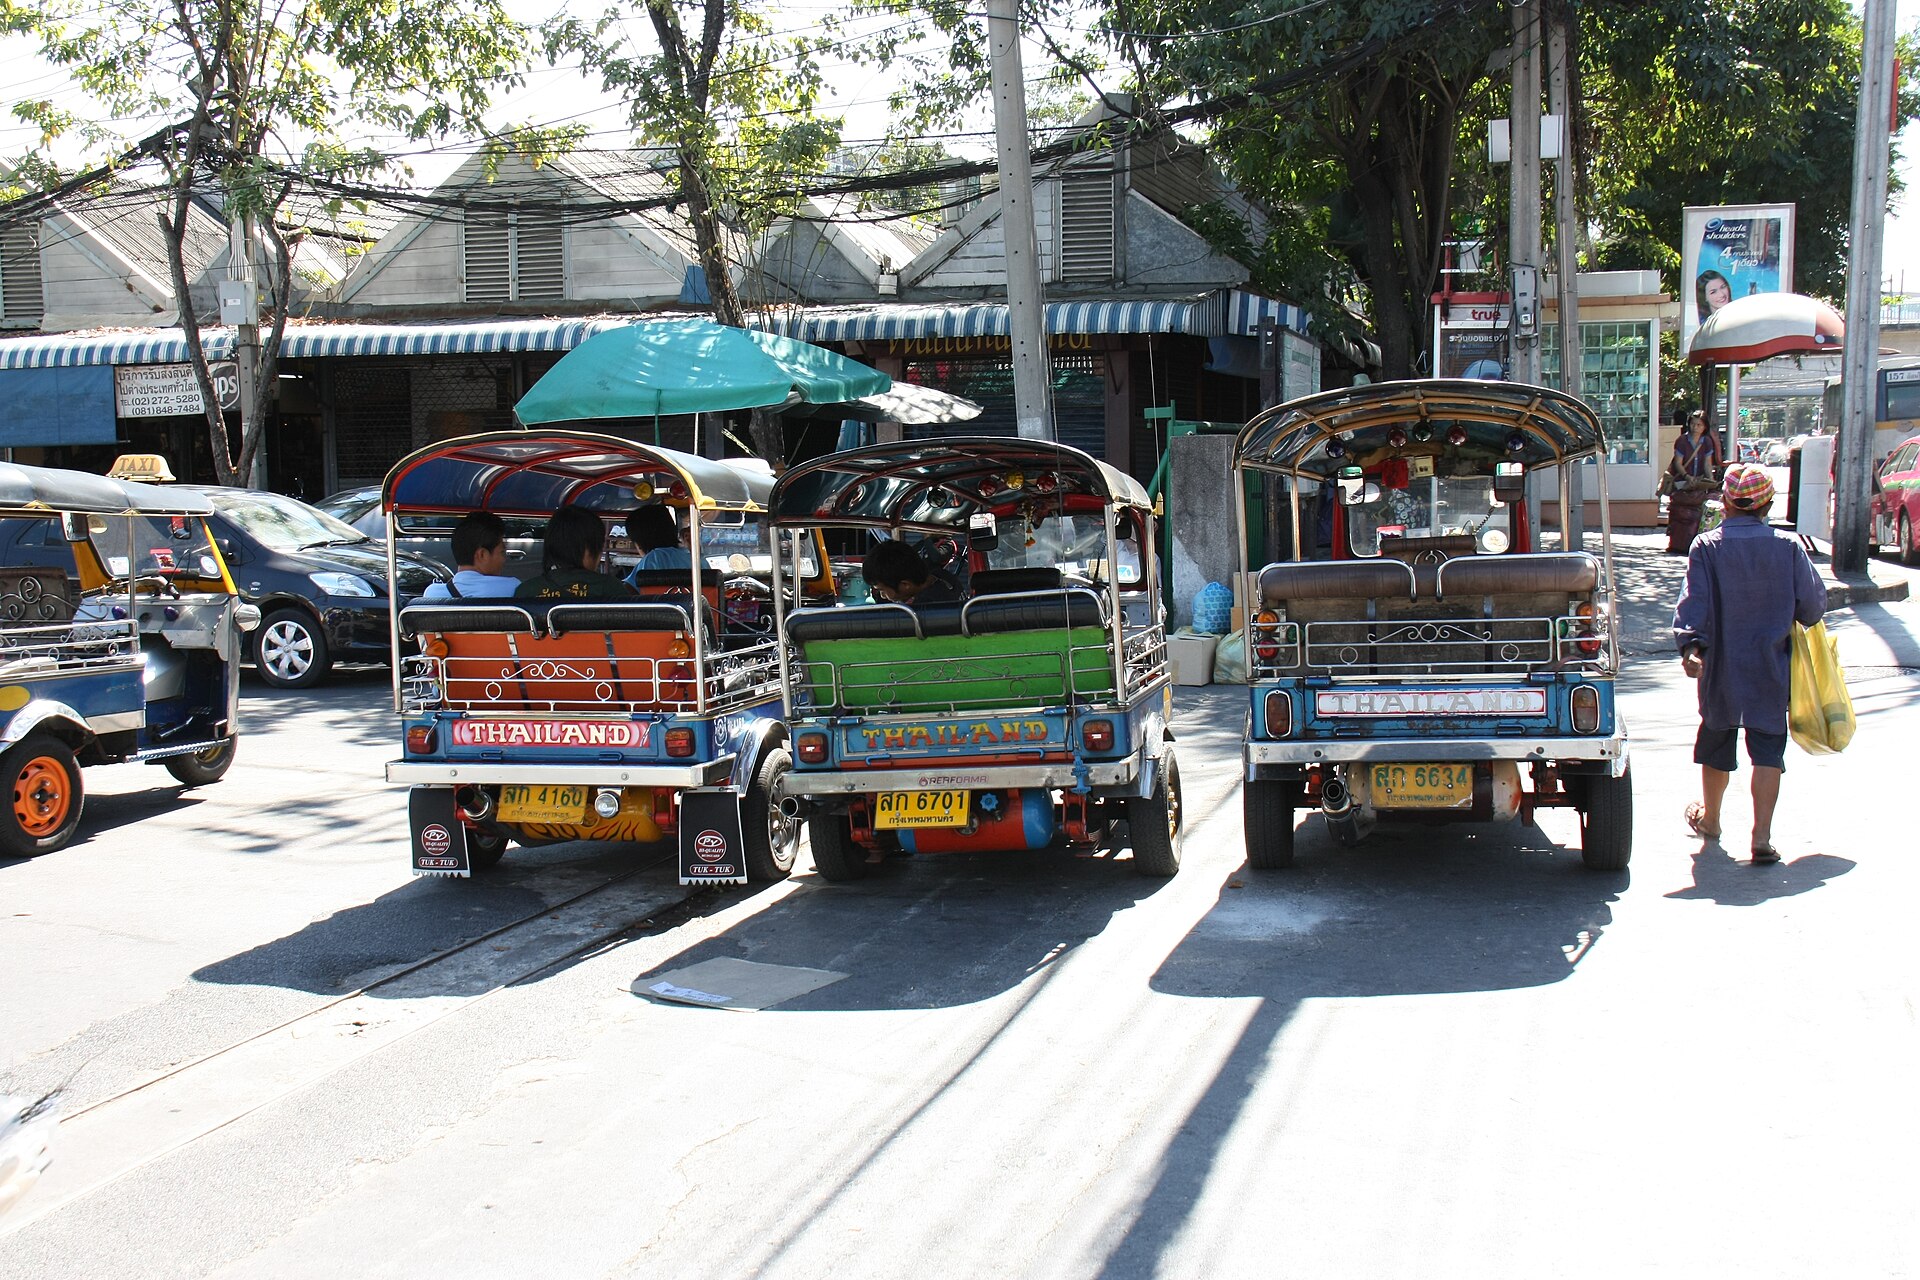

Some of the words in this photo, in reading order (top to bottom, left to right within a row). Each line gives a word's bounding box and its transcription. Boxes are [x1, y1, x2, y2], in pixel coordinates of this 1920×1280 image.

[1706, 232, 1746, 240] shoulders
[1471, 309, 1501, 321] true
[119, 457, 156, 472] TAXI
[1331, 692, 1530, 713] THAILAND
[469, 722, 632, 746] THAILAND
[862, 720, 1049, 749] THAILAND
[1415, 767, 1468, 788] 6634
[538, 787, 583, 807] 4160
[880, 791, 908, 812] สก
[916, 791, 965, 811] 6701
[889, 815, 955, 827] กรุงเทพมหานคร
